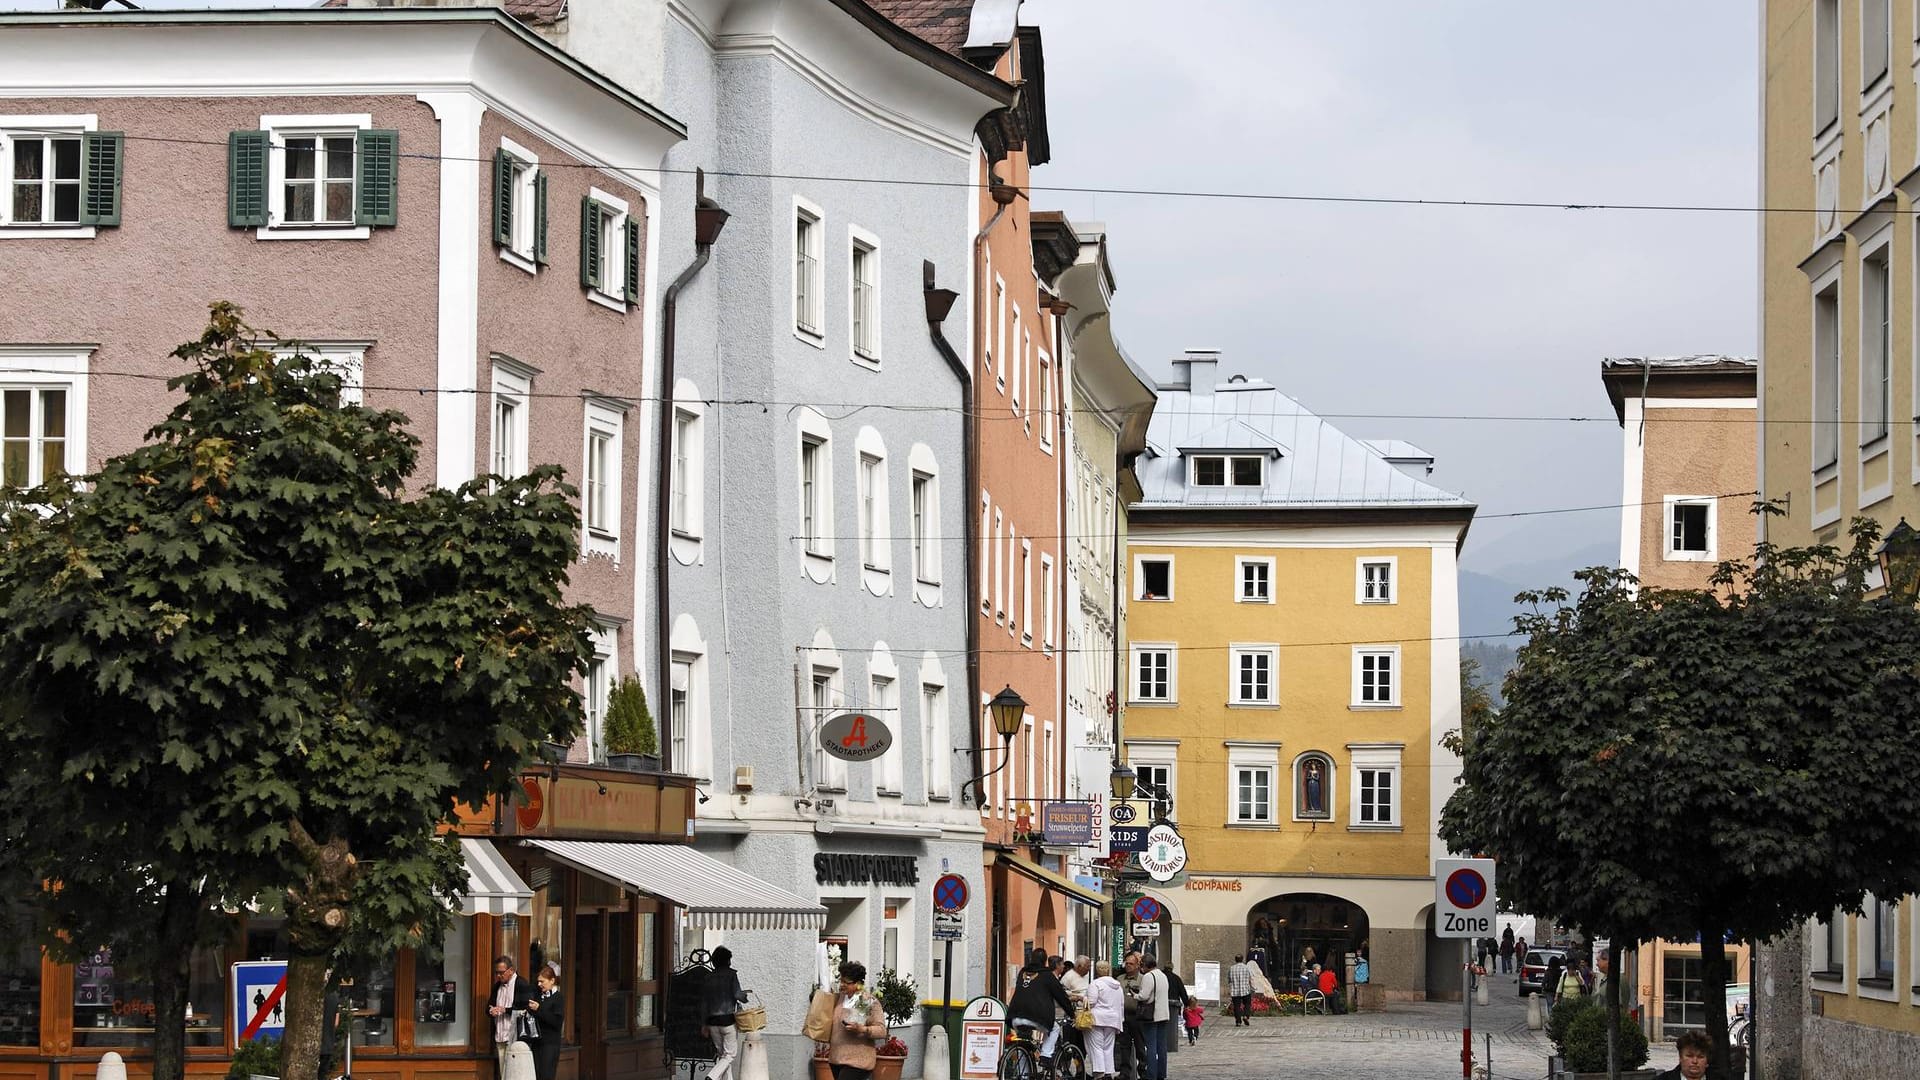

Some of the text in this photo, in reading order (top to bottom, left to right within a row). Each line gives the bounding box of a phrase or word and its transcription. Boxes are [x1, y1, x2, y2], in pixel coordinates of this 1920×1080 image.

[825, 739, 884, 757] STADTAPOTHEKE
[1049, 814, 1088, 823] FRISEUR
[1110, 831, 1138, 842] KIDS
[814, 852, 919, 888] STADTAPOTHEKE
[1143, 855, 1183, 873] STADTKRUG
[1444, 912, 1489, 932] Zone
[112, 999, 156, 1016] Coffee
